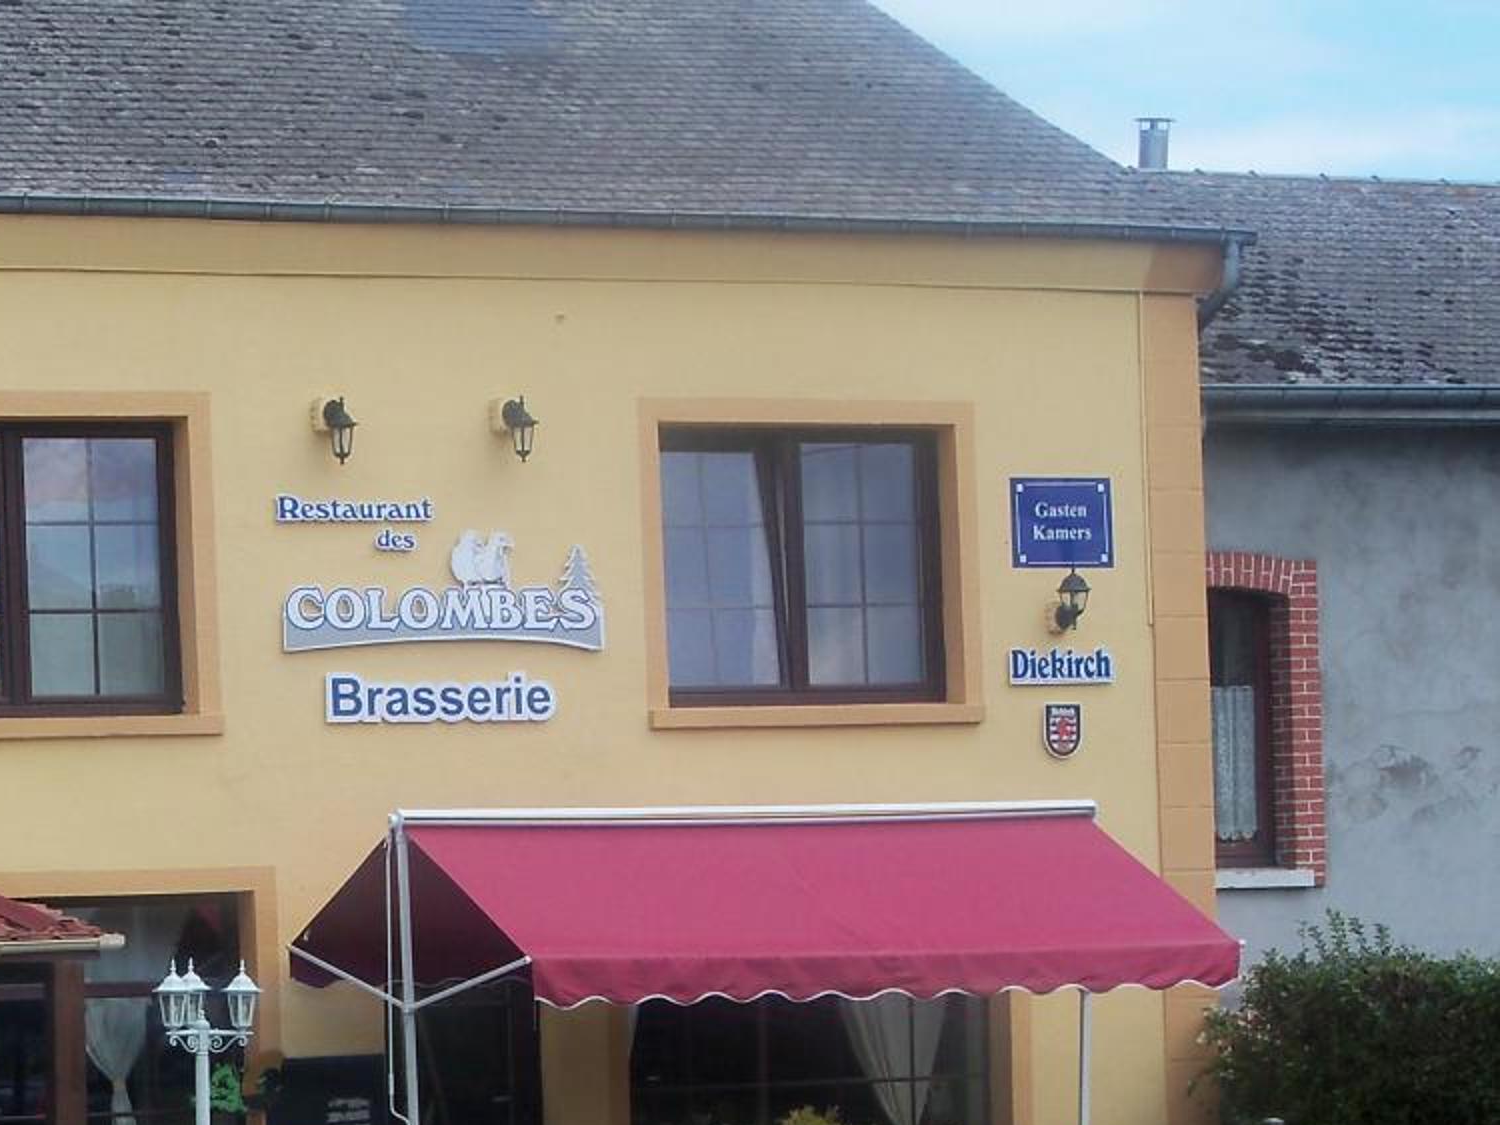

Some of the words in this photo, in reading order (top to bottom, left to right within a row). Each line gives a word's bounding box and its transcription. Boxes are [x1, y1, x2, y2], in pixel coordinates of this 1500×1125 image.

[278, 496, 432, 519] Restaurant
[1035, 502, 1087, 518] Gasten
[377, 530, 415, 549] des
[1033, 525, 1092, 541] Kamers
[285, 587, 598, 631] COLOMBES
[1011, 648, 1111, 679] Diekirch
[331, 676, 551, 716] Brasserie
